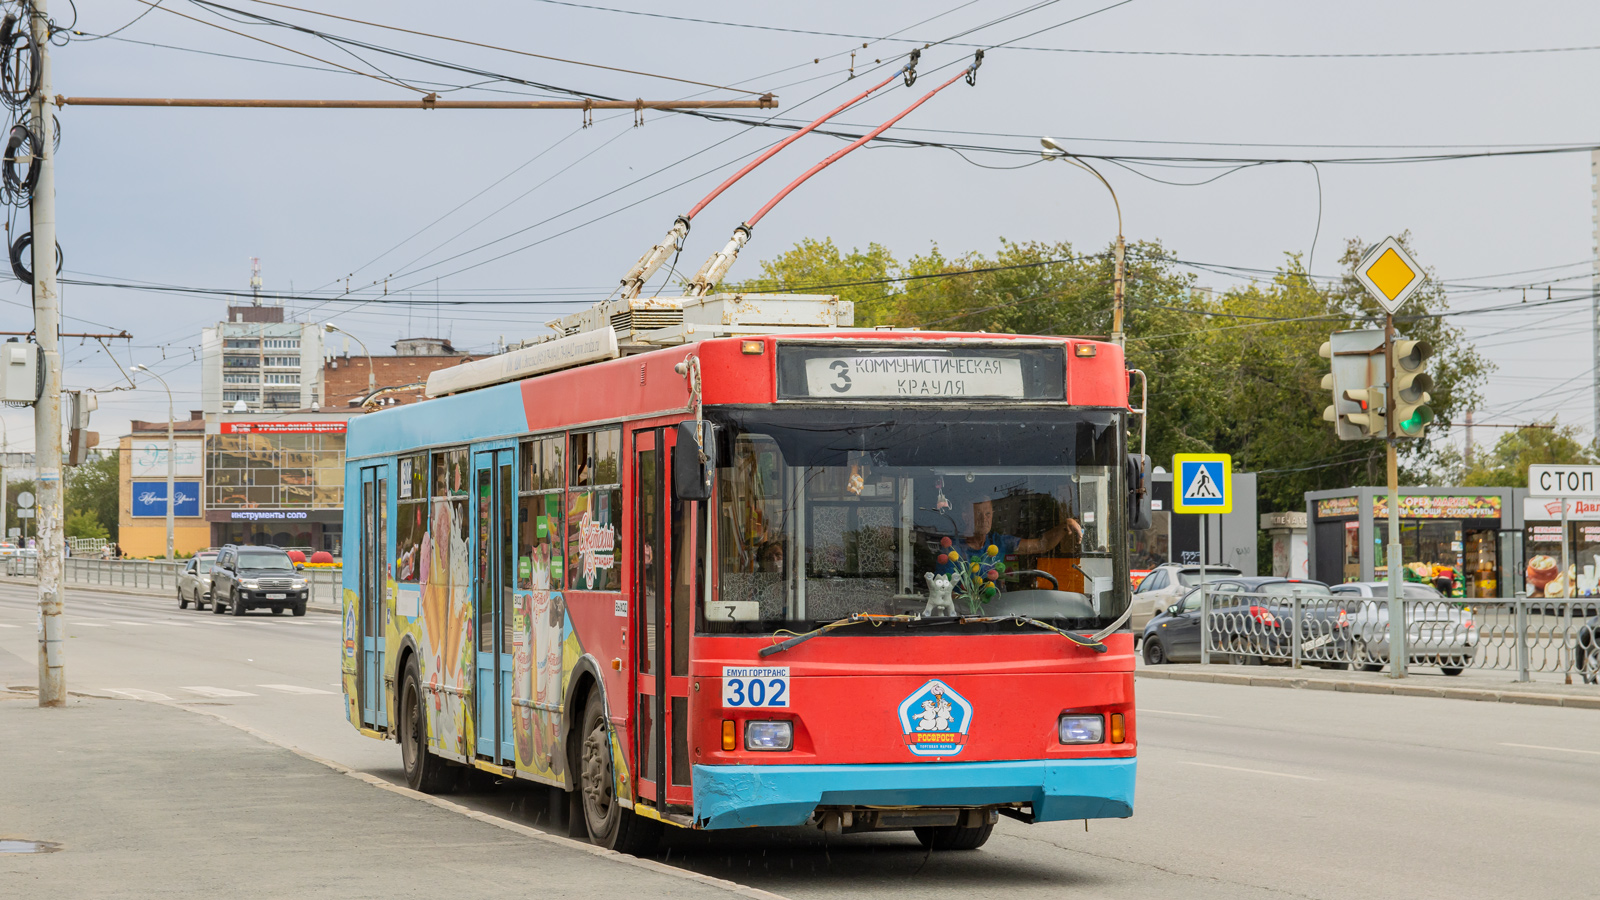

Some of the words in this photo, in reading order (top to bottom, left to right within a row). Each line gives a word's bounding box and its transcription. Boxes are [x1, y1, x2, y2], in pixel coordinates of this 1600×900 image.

[855, 358, 1002, 375] КОММУНИСТИЧЕСКАЯ
[829, 360, 852, 393] 3
[897, 379, 965, 395] КРАУЛЯ
[258, 422, 313, 432] УРАЛЬСКИЙ
[1540, 471, 1593, 491] СТОП
[1405, 497, 1469, 507] ОРЕХ-МАРКЕТ
[231, 512, 286, 520] инструменты
[1413, 507, 1442, 515] ОВОЩИ
[1446, 507, 1494, 515] СУХОФРУКТЫ
[727, 669, 747, 677] ЕМУП
[749, 669, 786, 677] ГОРТРАНС
[727, 679, 786, 706] 302
[917, 733, 955, 742] РОСФРОСТ
